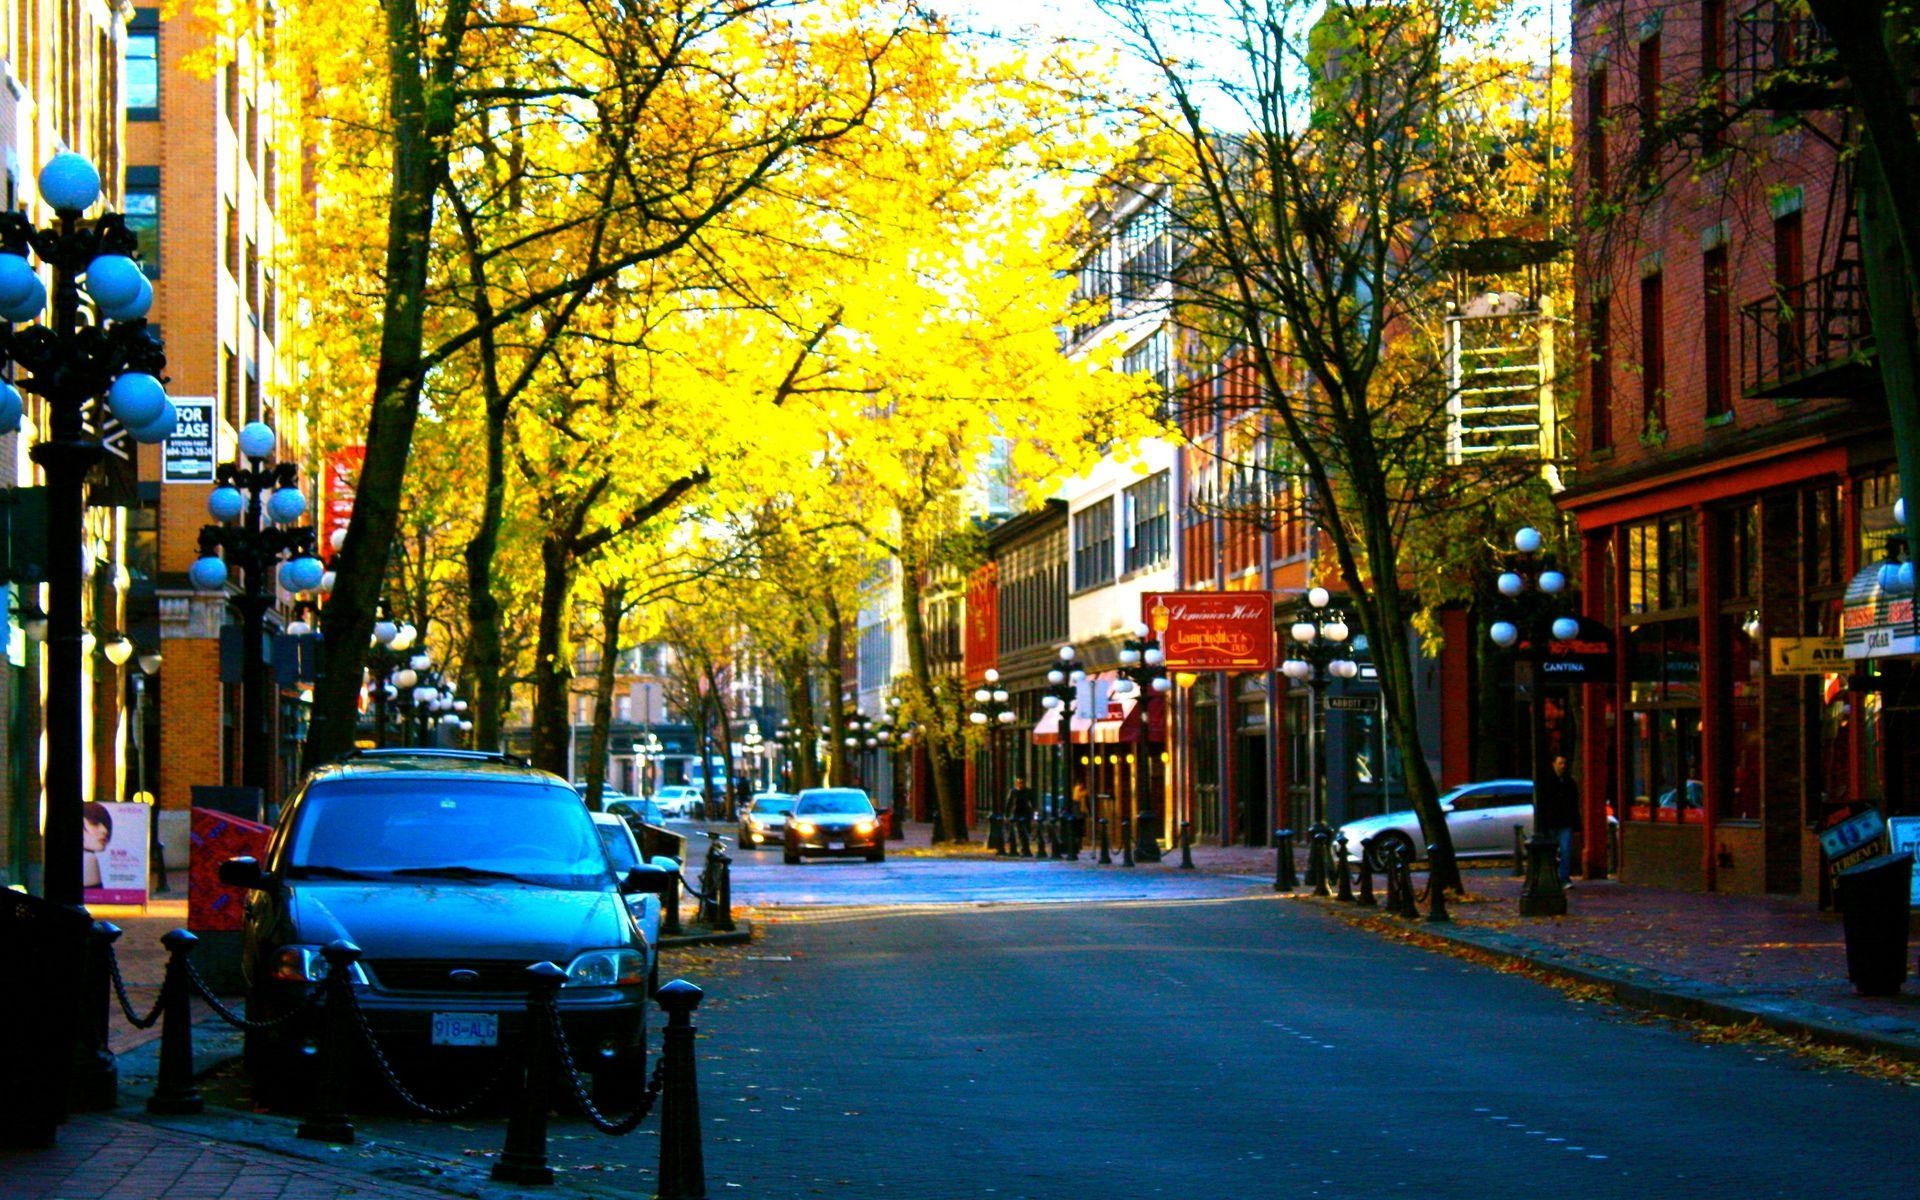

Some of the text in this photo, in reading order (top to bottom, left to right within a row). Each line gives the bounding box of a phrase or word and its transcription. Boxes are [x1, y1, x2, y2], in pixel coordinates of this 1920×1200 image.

[177, 408, 202, 422] FOR
[1171, 603, 1264, 621] Dominion Hotel
[1543, 661, 1585, 672] CANTINA
